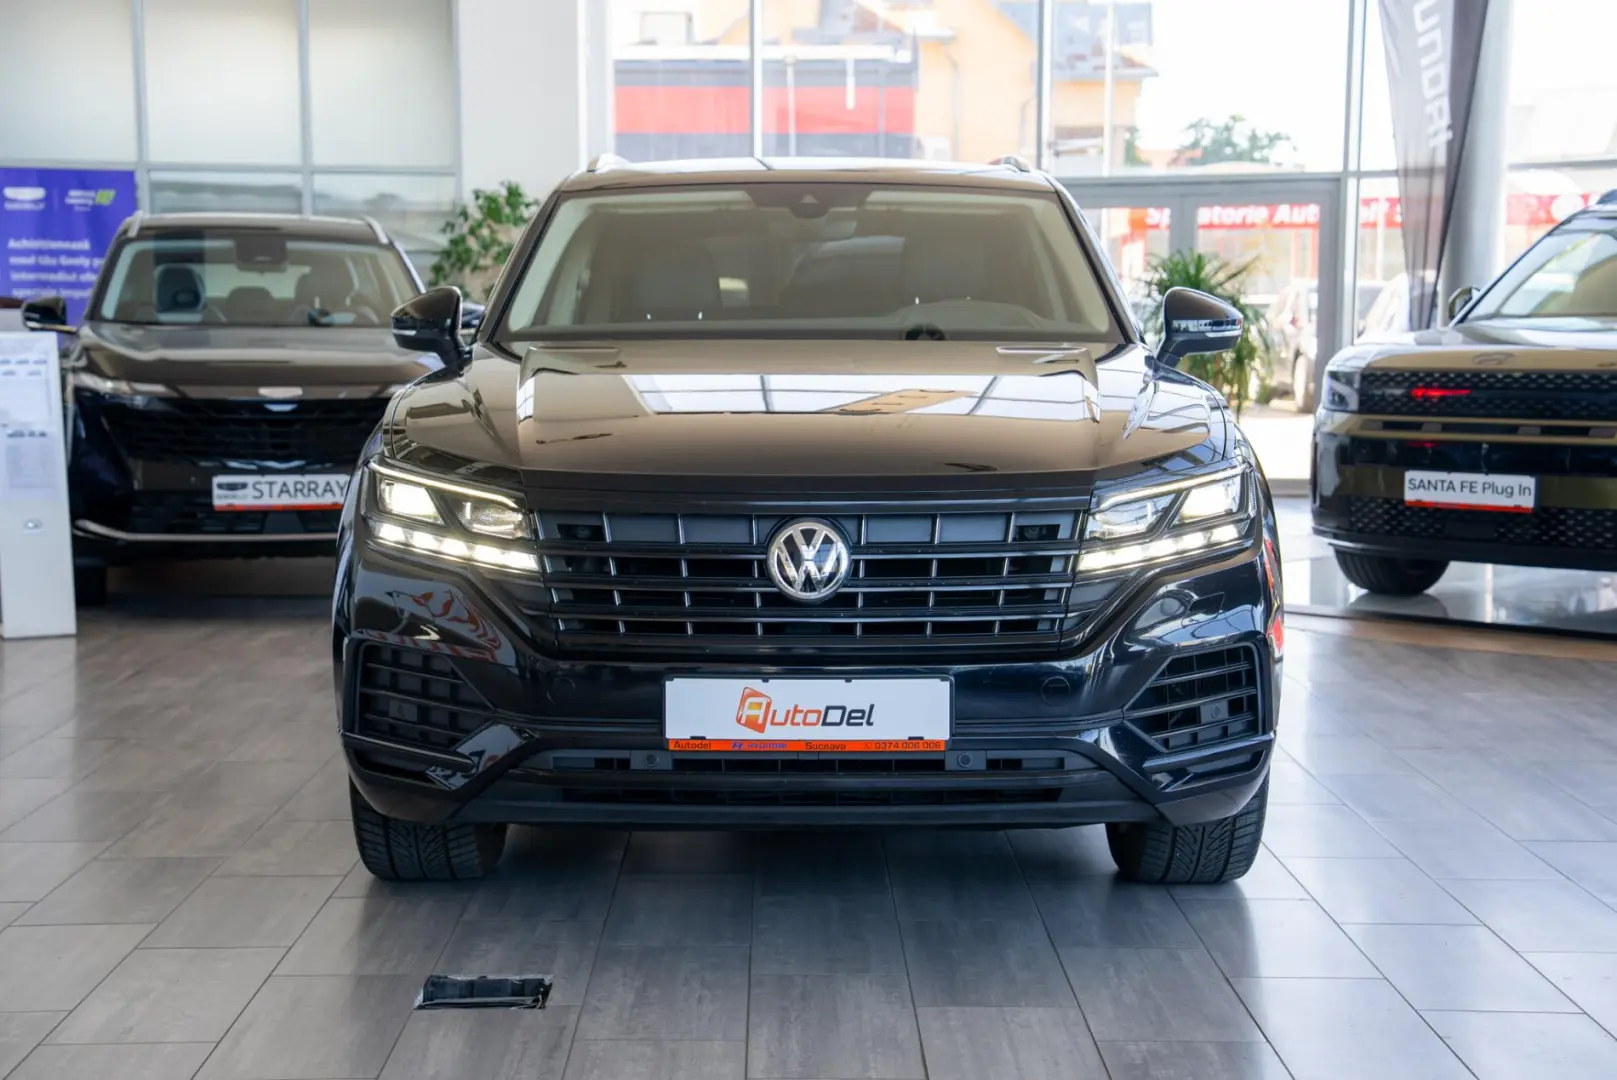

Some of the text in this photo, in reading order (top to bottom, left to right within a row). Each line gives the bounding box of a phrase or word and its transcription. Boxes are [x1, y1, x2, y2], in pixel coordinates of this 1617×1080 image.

[1272, 203, 1320, 224] Aut
[251, 480, 347, 499] STARRAY
[1408, 478, 1532, 498] SANTA FE Plug In
[738, 691, 875, 731] AutoDel
[673, 740, 712, 750] Autodel
[804, 741, 847, 750] Suceava
[874, 741, 900, 750] 0374
